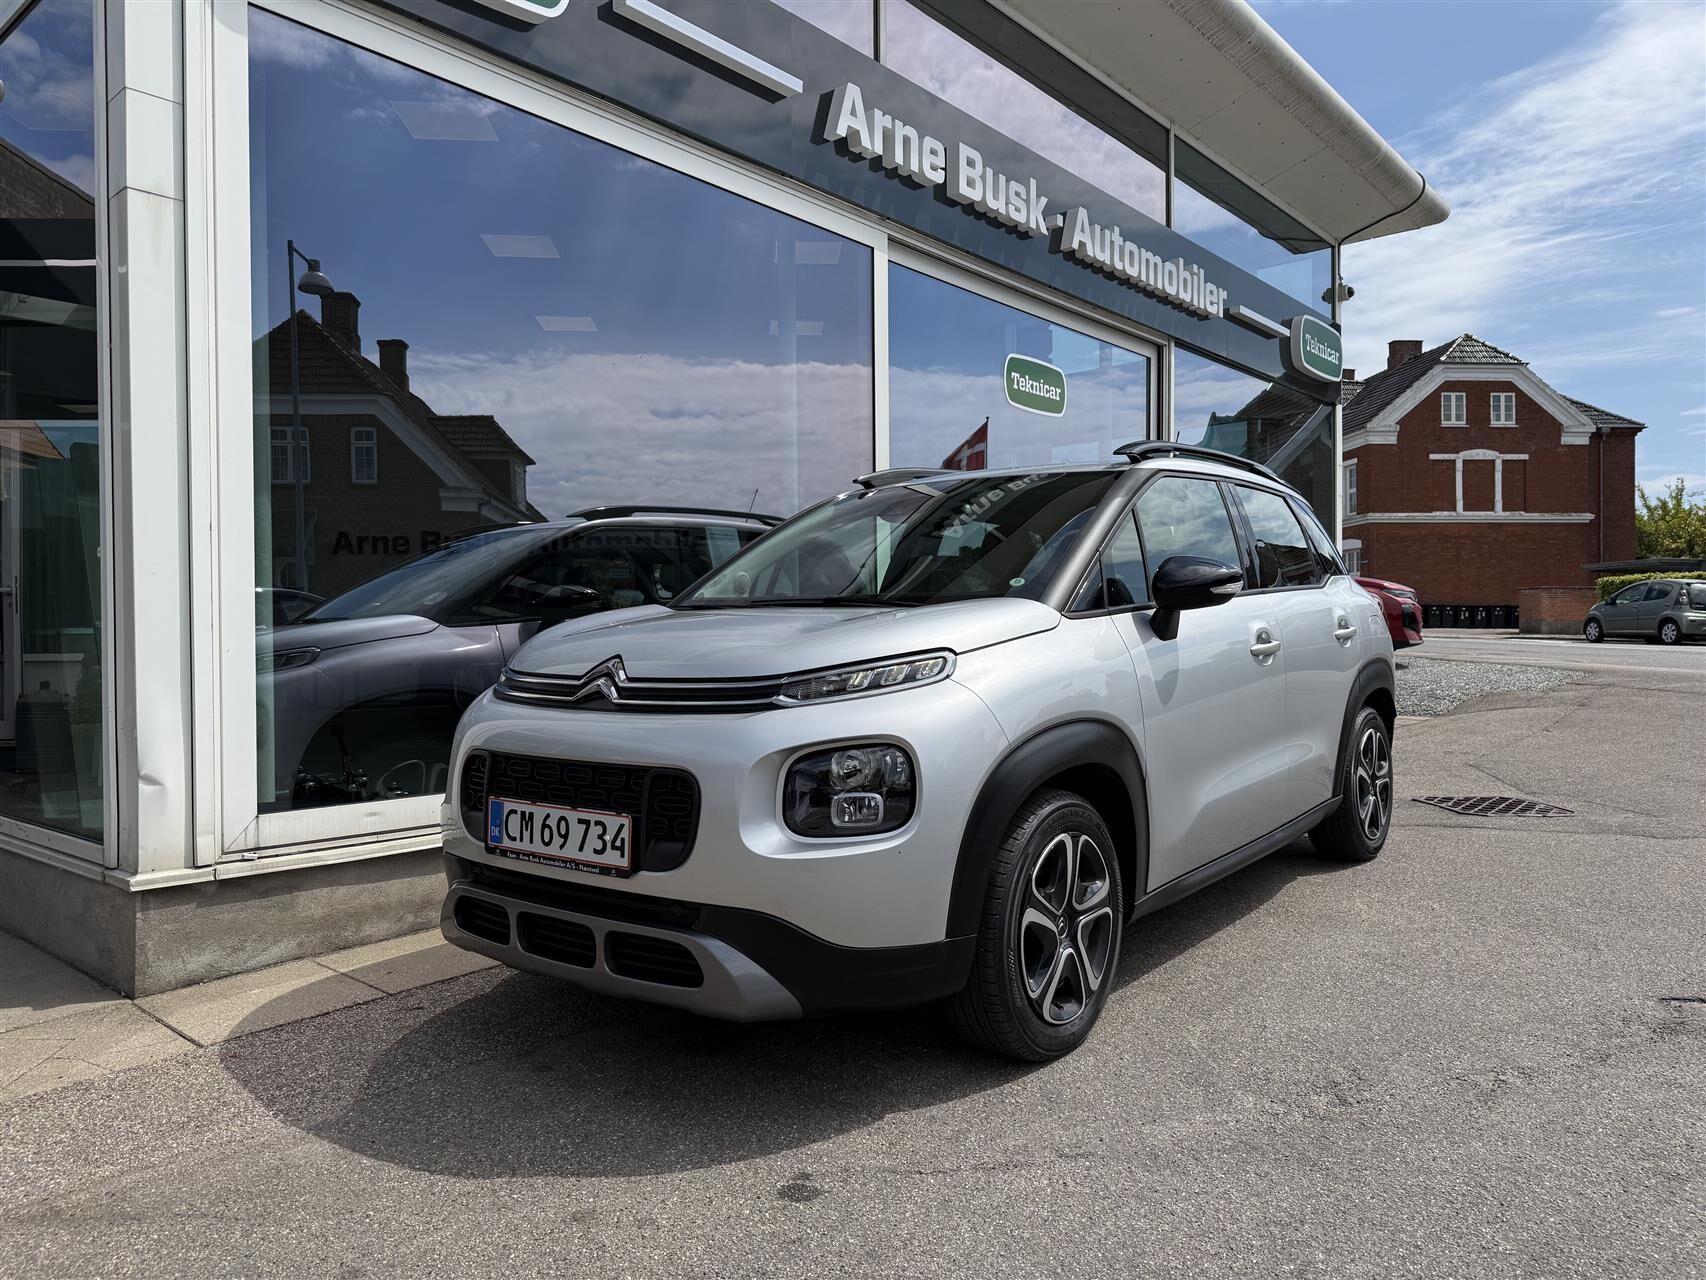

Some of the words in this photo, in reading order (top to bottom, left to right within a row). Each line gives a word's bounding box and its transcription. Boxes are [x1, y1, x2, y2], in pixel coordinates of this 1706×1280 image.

[834, 82, 946, 184] Arne
[957, 141, 1049, 237] Busk
[1069, 206, 1228, 318] Automobiler
[1306, 333, 1340, 365] Teknicar
[1011, 371, 1061, 401] Teknicar
[331, 530, 410, 555] Arne
[491, 826, 500, 837] DK
[504, 808, 535, 845] CM
[540, 812, 570, 851] 69
[577, 818, 626, 859] 734
